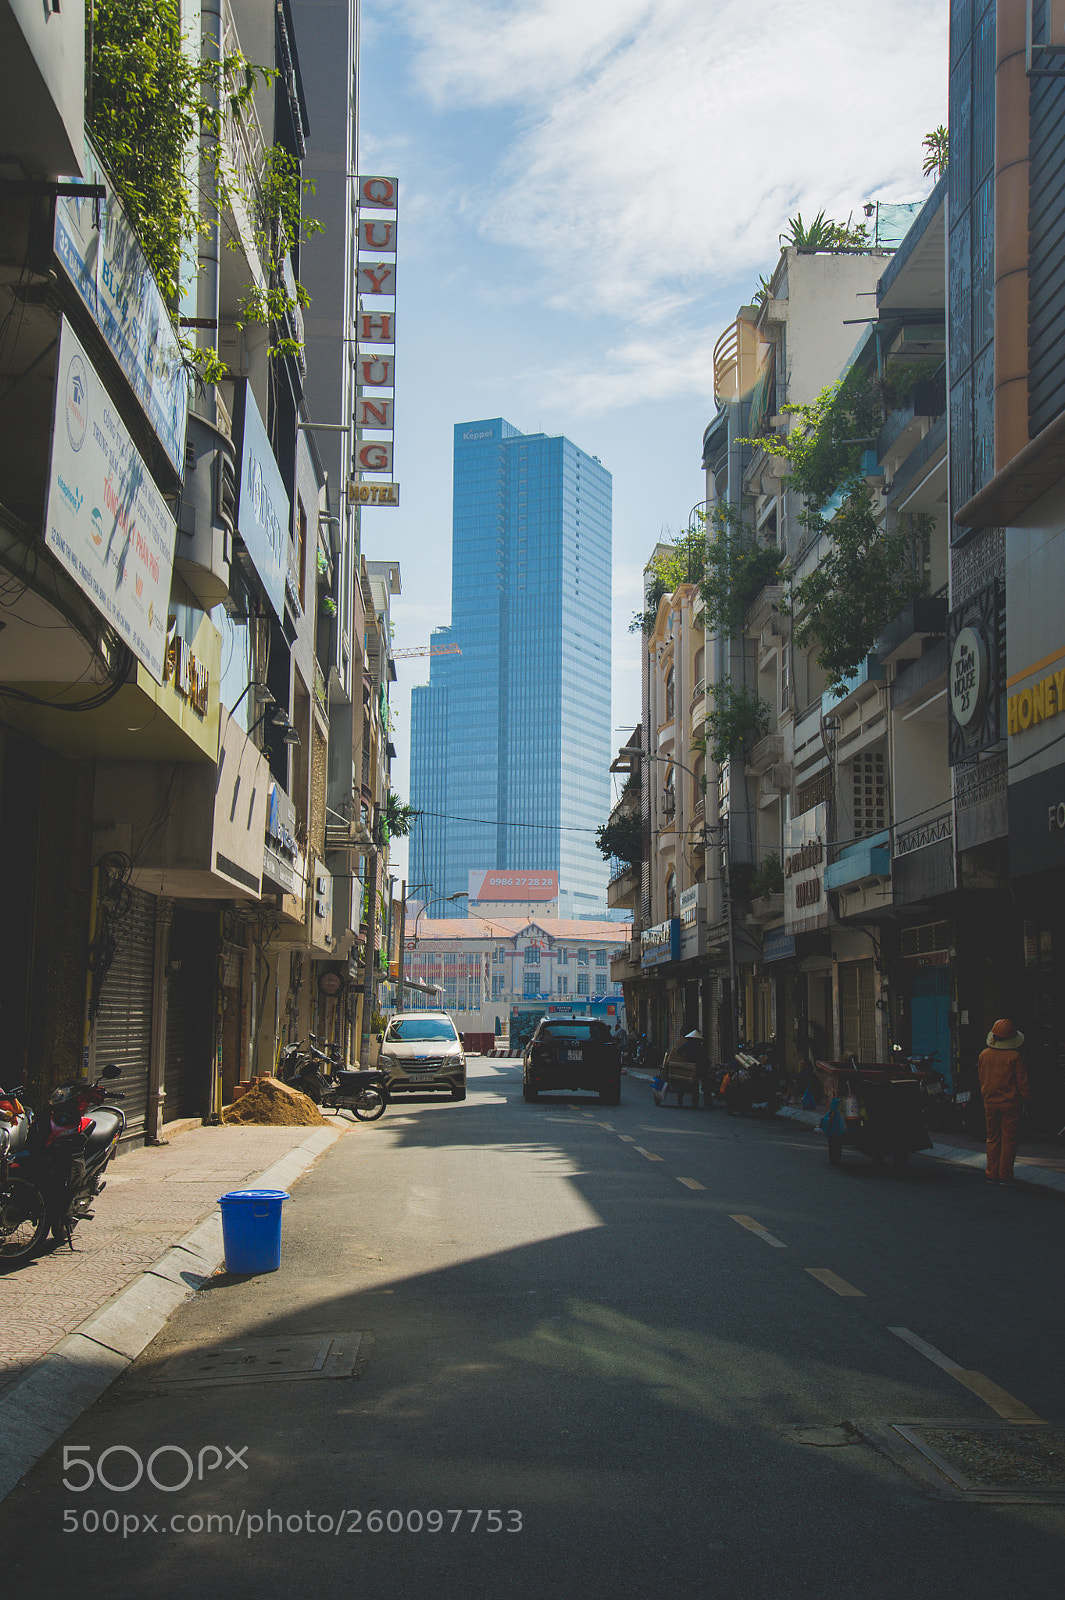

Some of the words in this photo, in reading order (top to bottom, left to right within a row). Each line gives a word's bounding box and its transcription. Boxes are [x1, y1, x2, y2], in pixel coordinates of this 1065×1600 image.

[59, 227, 68, 254] 32
[131, 316, 154, 375] STAR
[463, 429, 493, 440] Keppel
[57, 475, 77, 508] vinaphone
[350, 484, 397, 503] HOTEL
[103, 475, 120, 520] TỔNG
[135, 532, 149, 567] PHÂN
[148, 552, 159, 584] PHỐI
[955, 651, 975, 679] TOWN
[954, 669, 976, 698] HOUSE
[961, 691, 970, 712] 23
[489, 878, 513, 886] 0986
[515, 878, 526, 886] 27
[528, 878, 539, 886] 28
[541, 878, 553, 886] 28
[418, 941, 463, 951] GROUP
